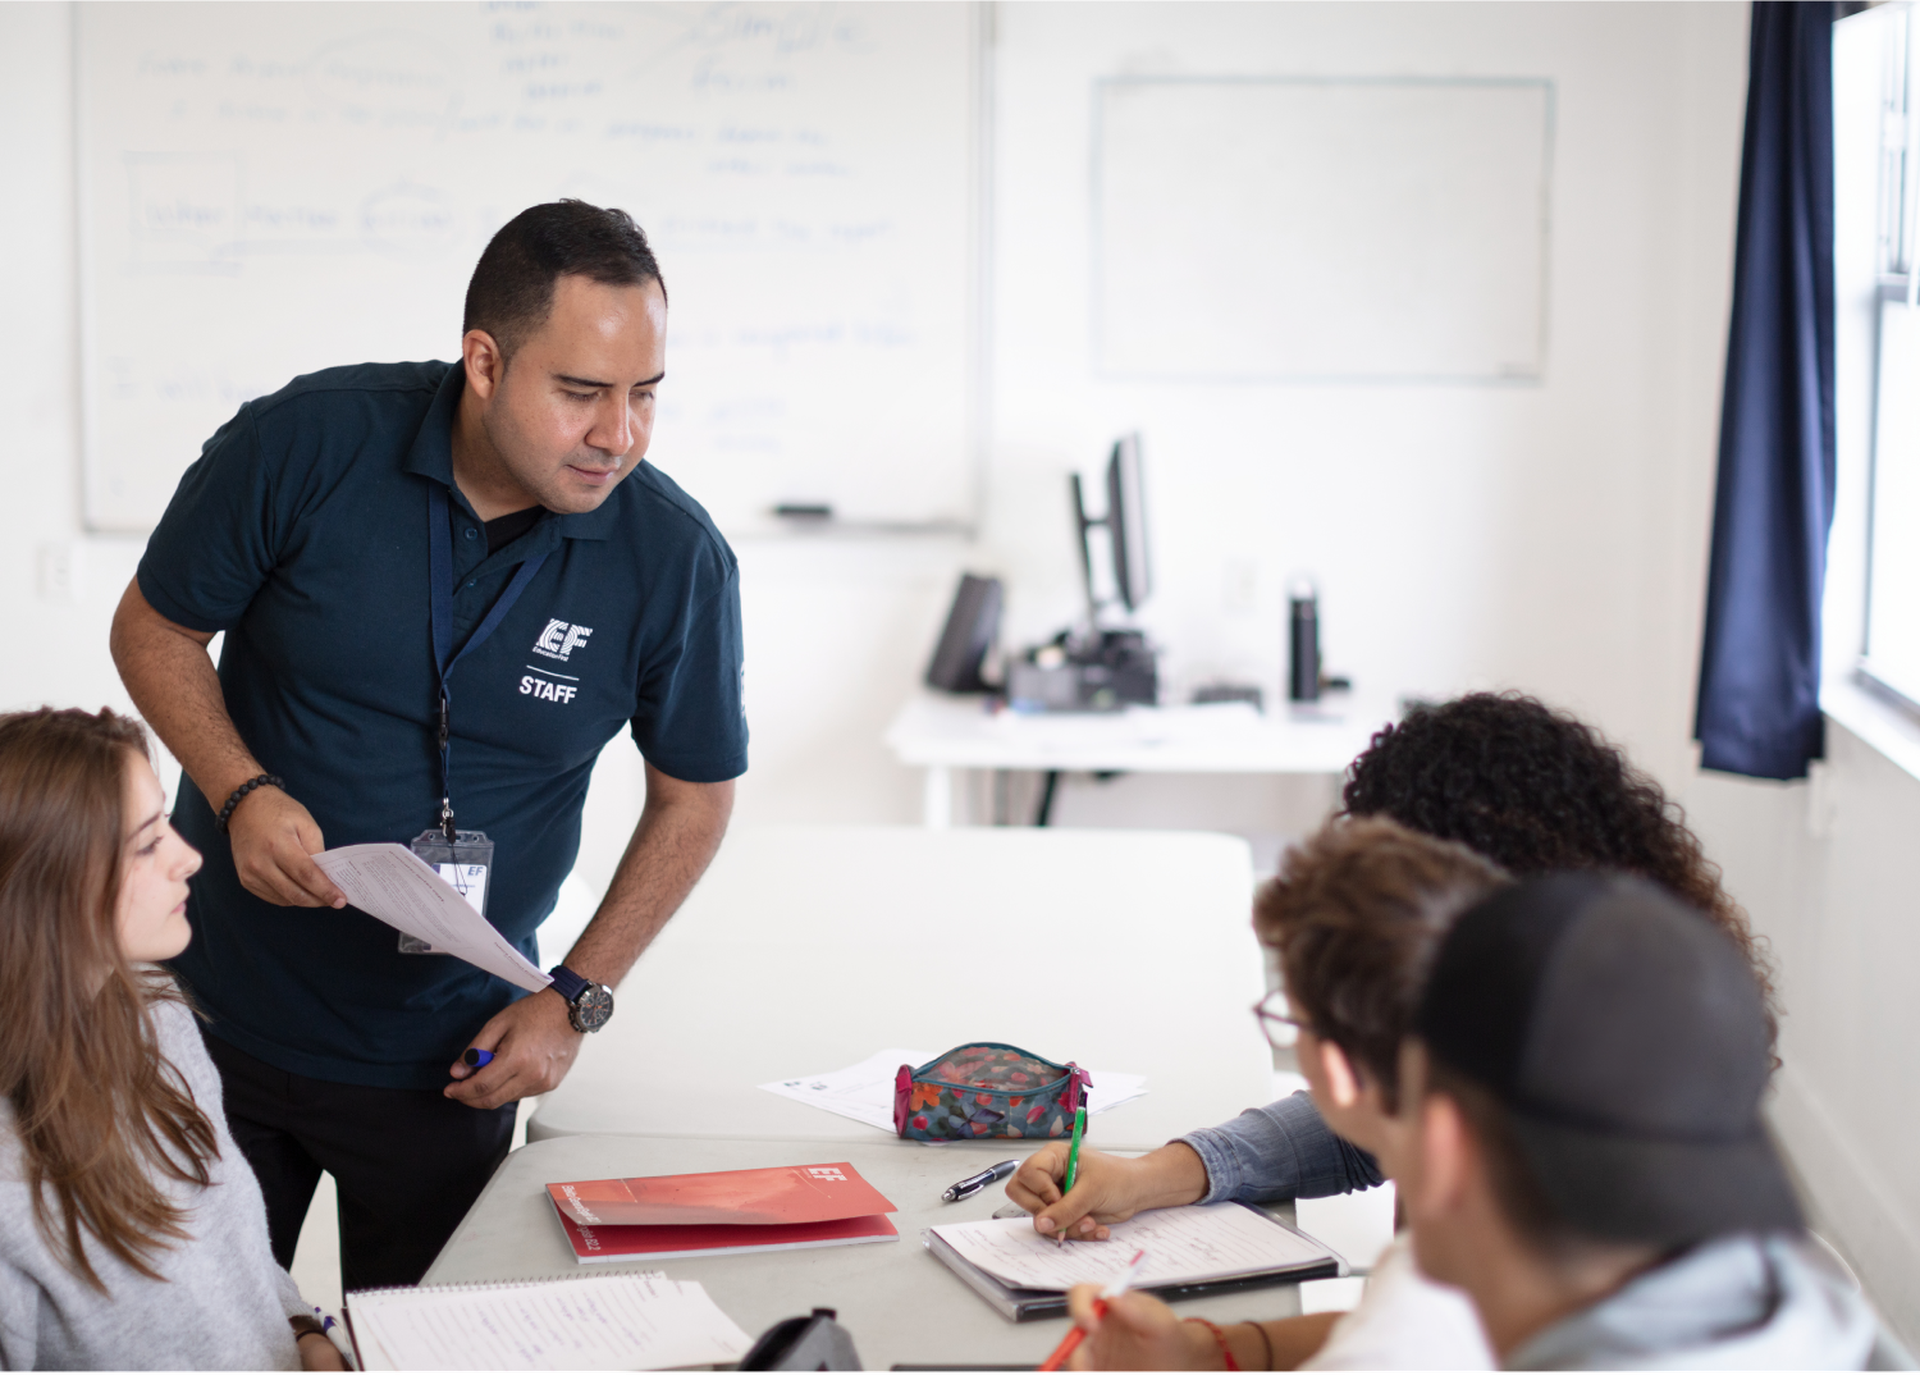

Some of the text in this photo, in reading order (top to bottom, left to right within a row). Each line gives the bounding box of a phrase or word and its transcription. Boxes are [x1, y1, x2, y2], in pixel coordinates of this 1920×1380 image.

[535, 618, 593, 655] EF
[519, 675, 577, 703] STAFF
[467, 866, 484, 876] EF
[807, 1168, 848, 1181] EF
